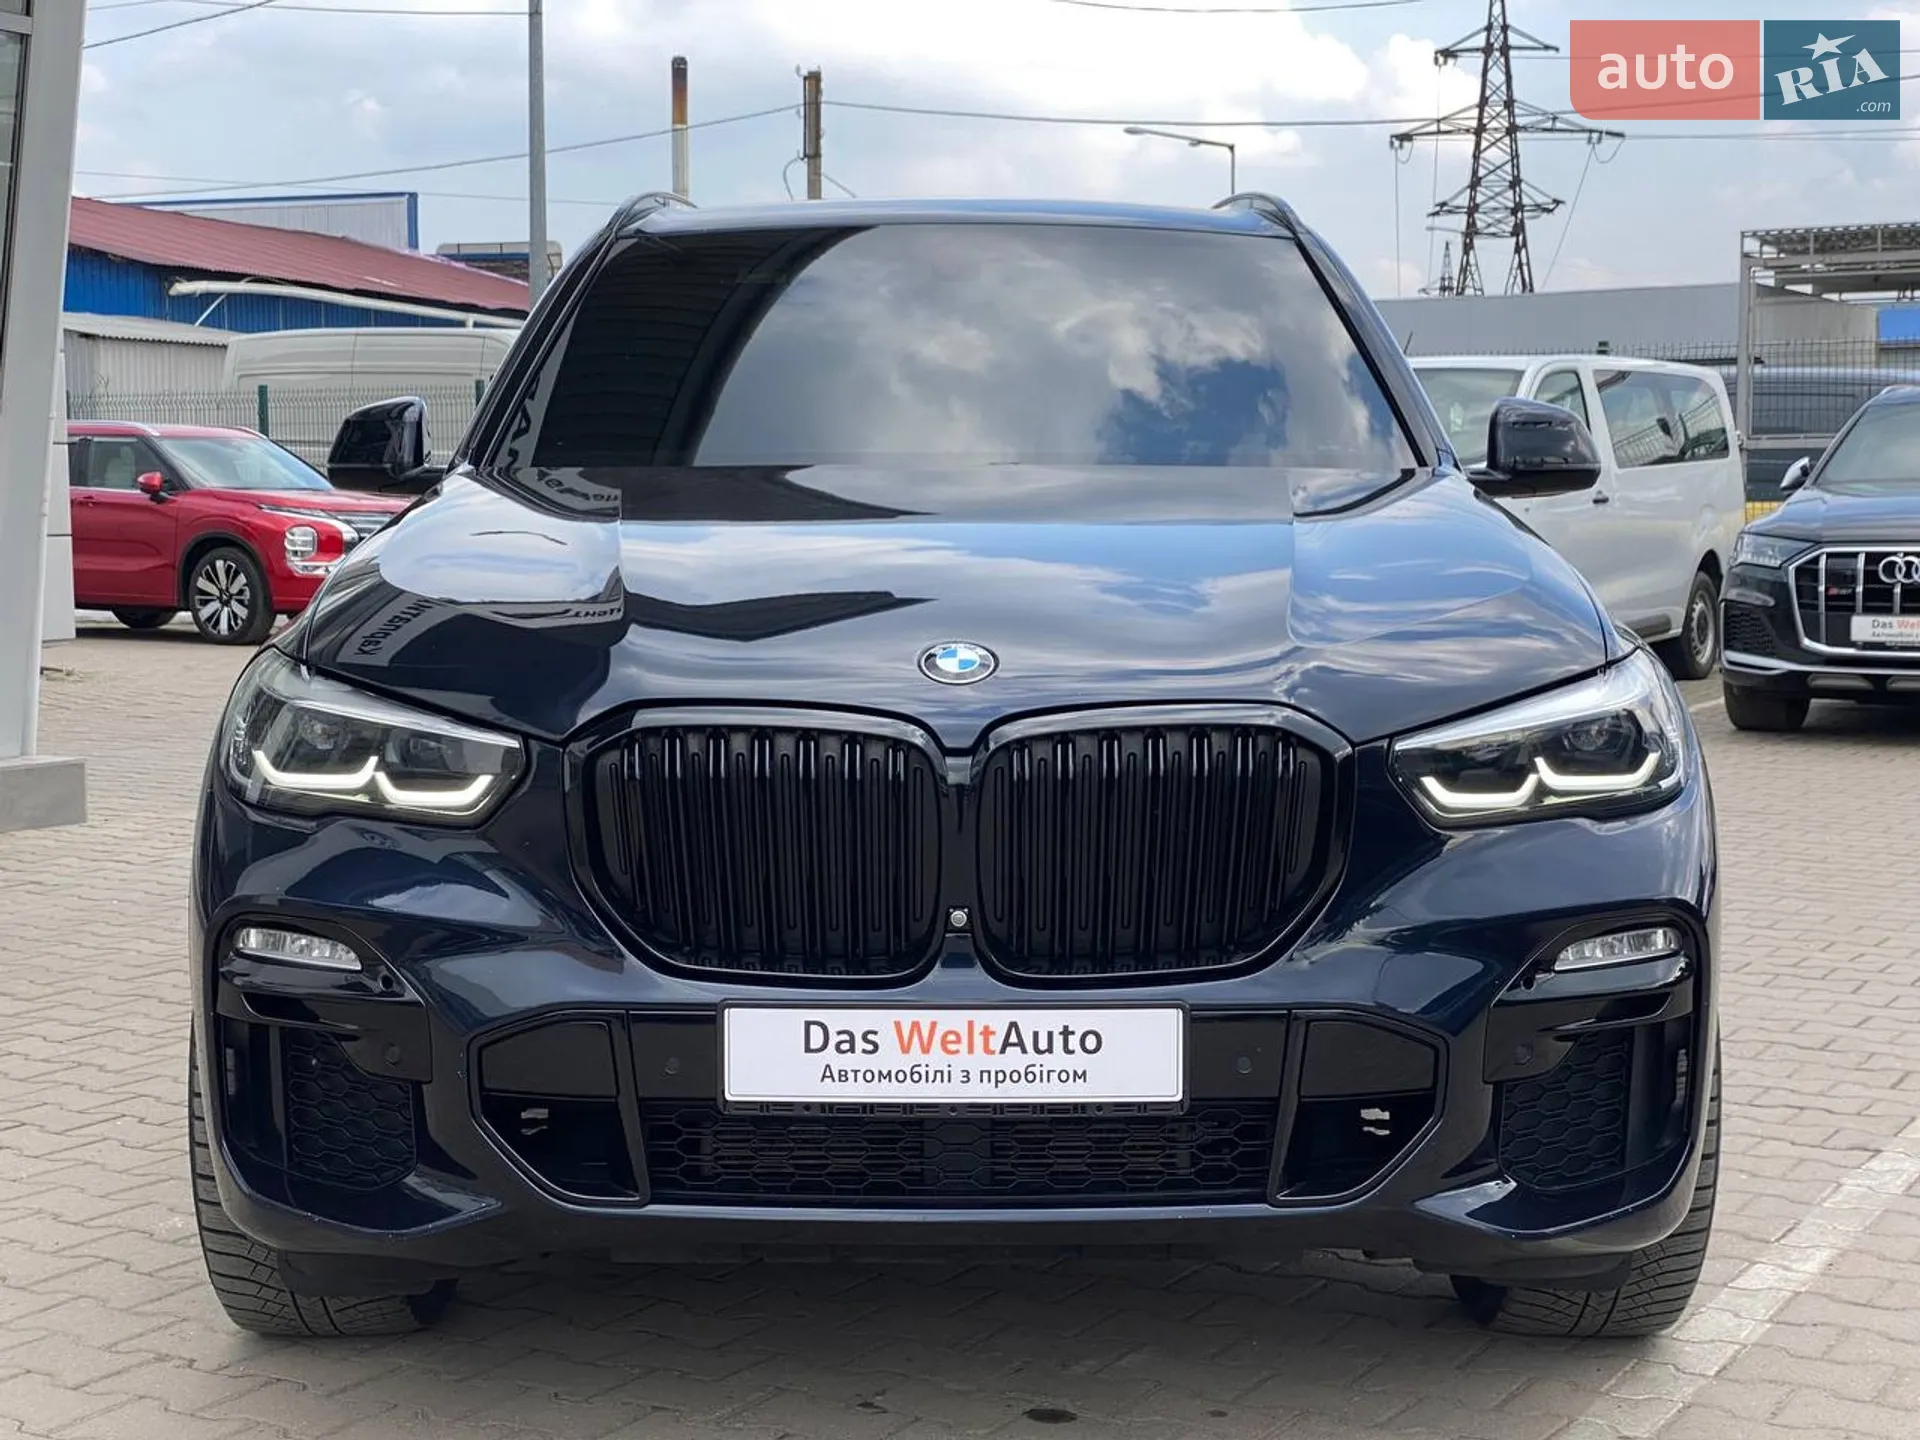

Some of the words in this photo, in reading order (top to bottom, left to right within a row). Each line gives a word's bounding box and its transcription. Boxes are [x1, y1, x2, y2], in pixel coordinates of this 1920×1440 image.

[1872, 619, 1893, 629] Das
[805, 1021, 880, 1055] Das
[895, 1021, 1103, 1055] WeltAuto
[821, 1064, 952, 1084] Автомобілі
[960, 1069, 971, 1084] з
[980, 1064, 1087, 1089] пробігом
